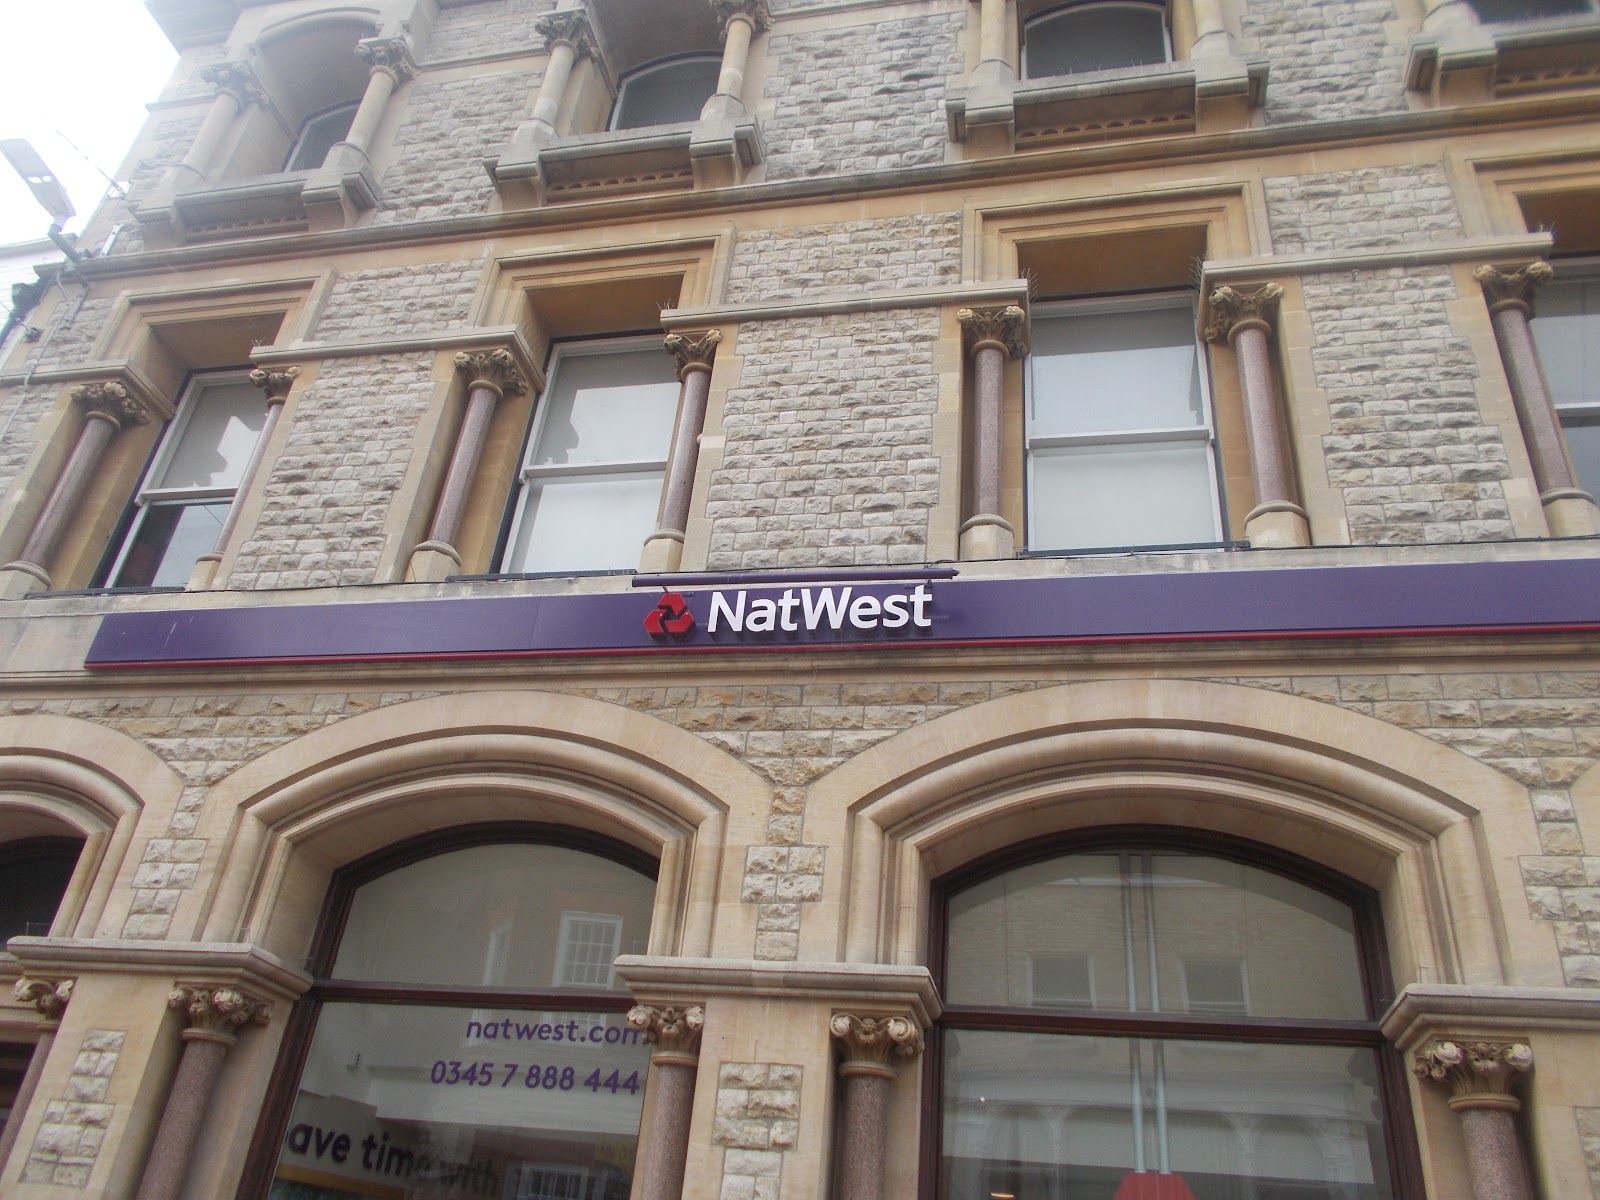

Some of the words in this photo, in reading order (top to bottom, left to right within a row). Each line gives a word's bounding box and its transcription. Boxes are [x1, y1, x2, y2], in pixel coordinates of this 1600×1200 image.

[707, 584, 933, 633] NatWest
[430, 1060, 494, 1086] 0345
[501, 1063, 519, 1088] 7
[524, 1064, 575, 1091] 888
[583, 1067, 640, 1095] 444
[285, 1123, 351, 1162] ave
